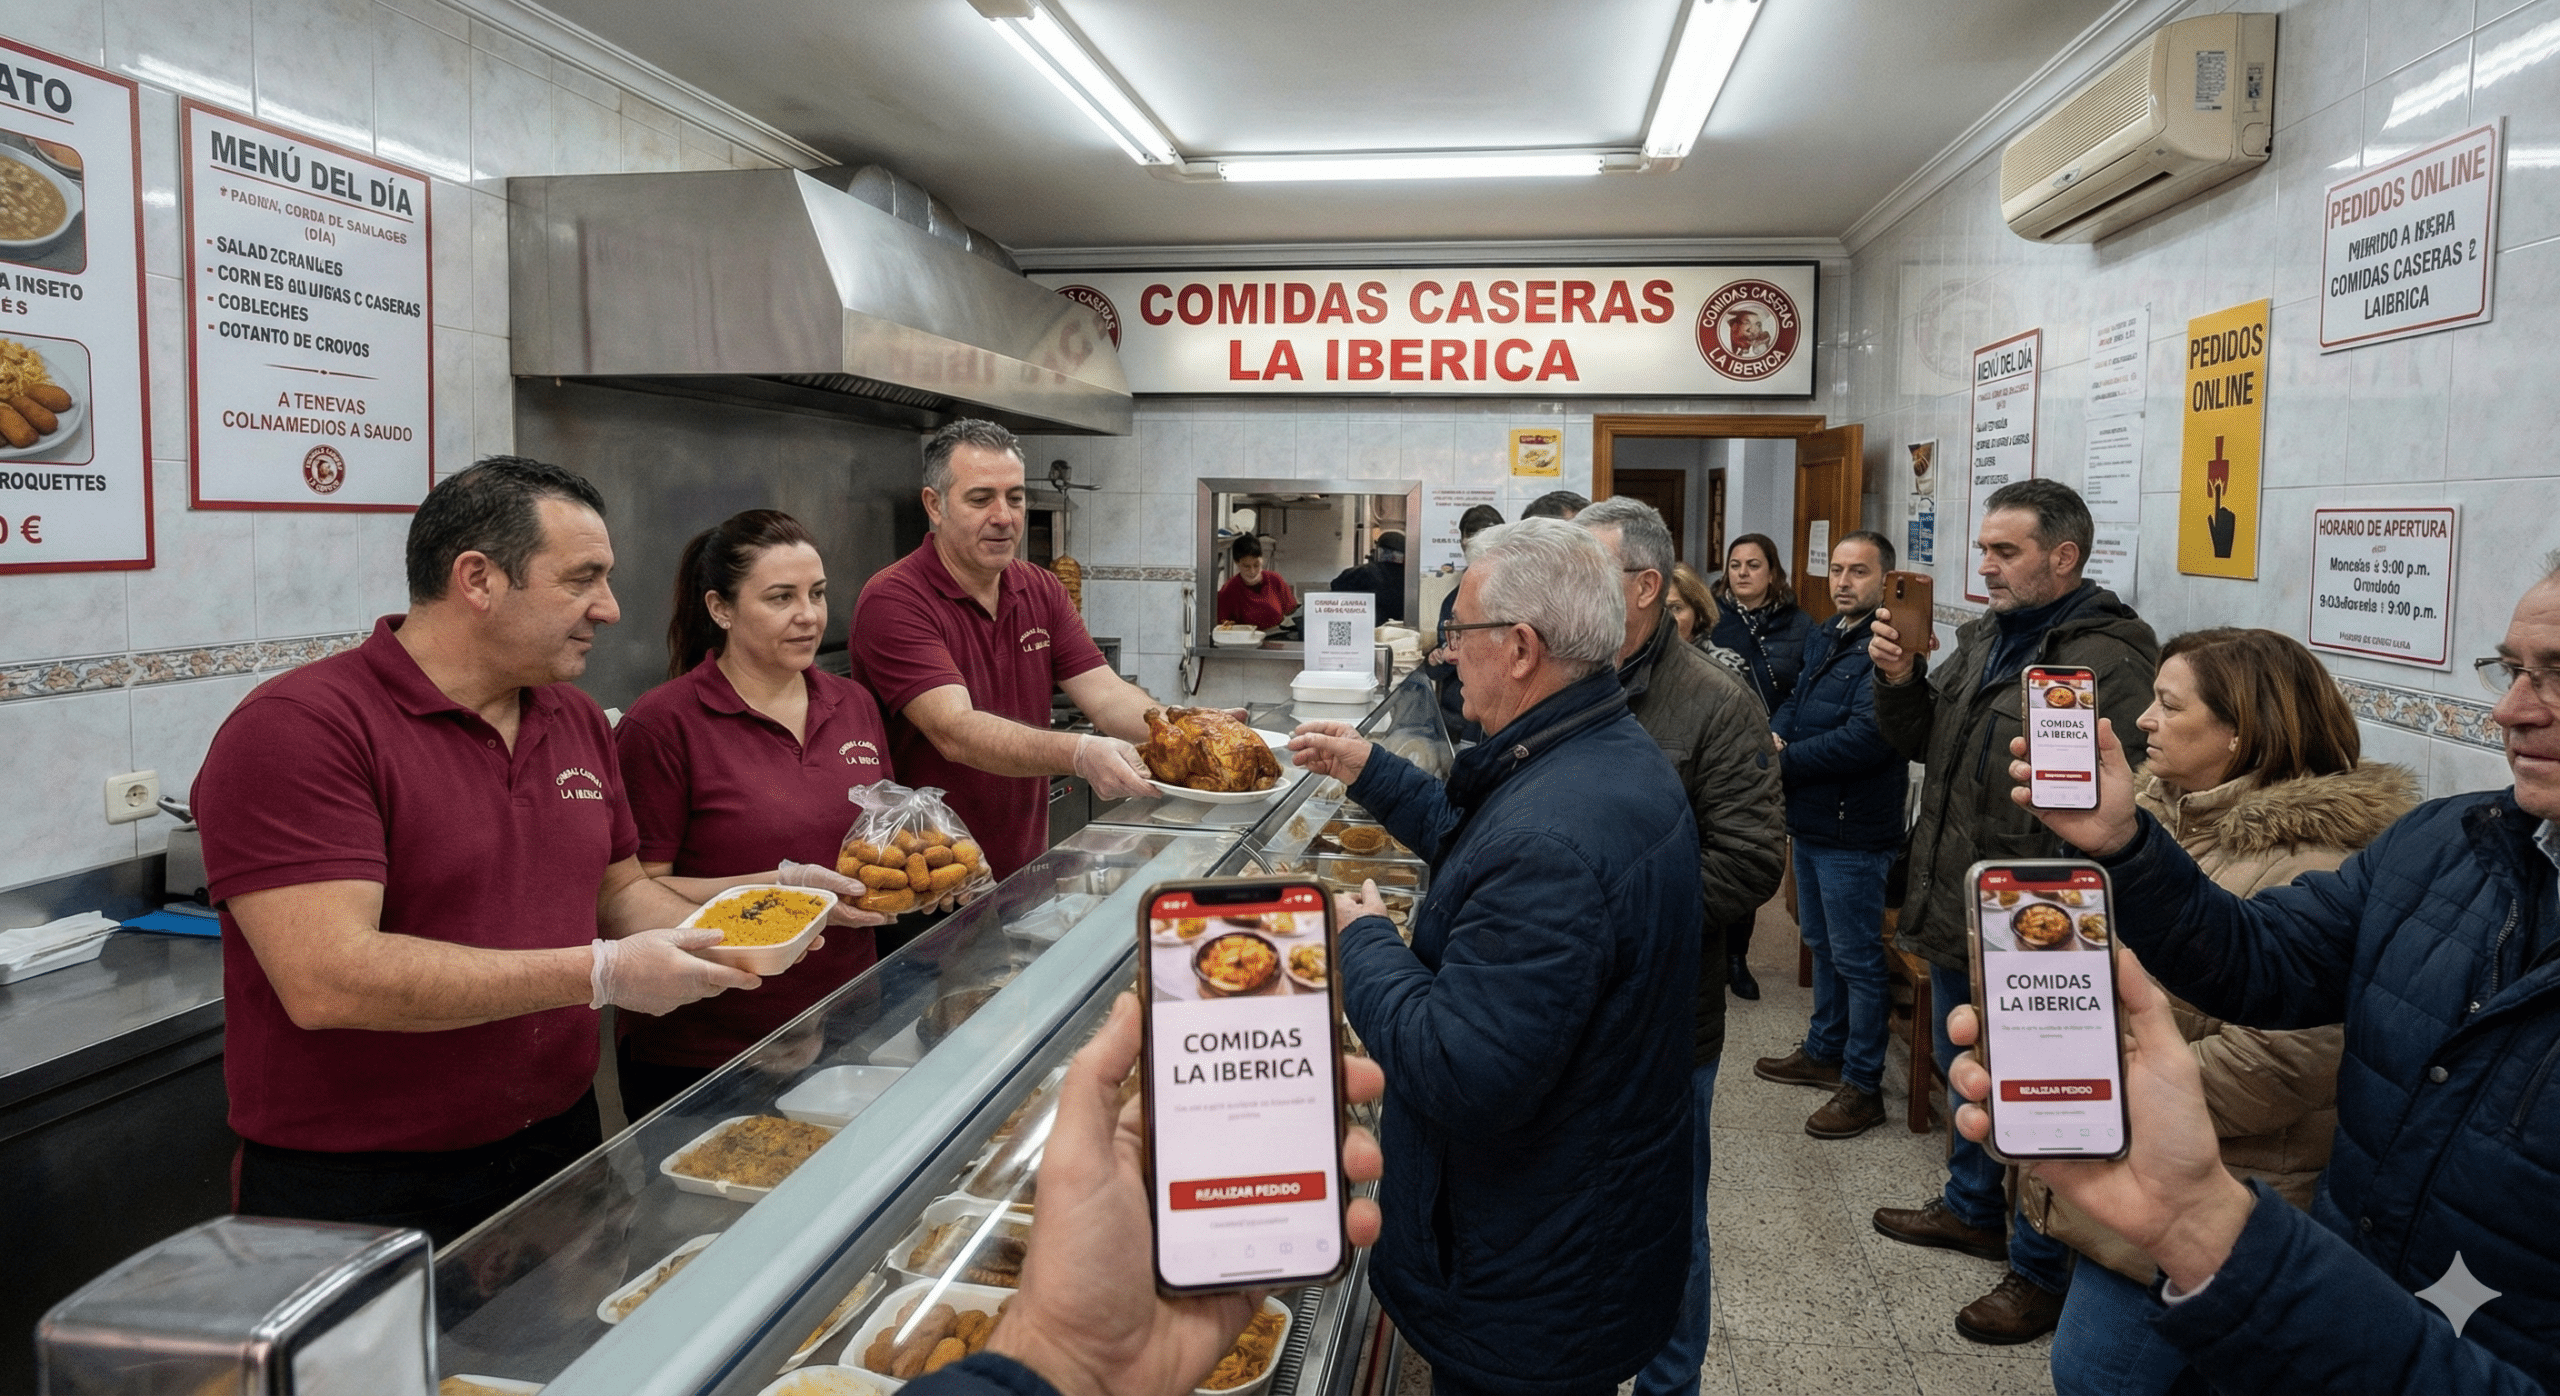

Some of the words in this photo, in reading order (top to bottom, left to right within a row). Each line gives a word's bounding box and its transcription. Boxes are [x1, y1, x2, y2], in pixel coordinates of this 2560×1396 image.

[211, 130, 300, 183] MENÚ
[311, 161, 362, 202] DEL
[370, 178, 413, 216] DÍA
[2330, 177, 2405, 230] PEDIDOS
[2411, 144, 2486, 201] ONLINE
[328, 214, 344, 229] DE
[2401, 224, 2411, 246] A
[217, 236, 267, 261] SALAD
[2331, 262, 2389, 297] COMIDAS
[2393, 241, 2463, 281] CASERAS
[15, 274, 84, 301] INSETO
[218, 265, 261, 288] CORN
[264, 273, 284, 291] ES
[365, 293, 421, 318] CASERAS
[218, 293, 309, 322] COBLECHES
[1140, 280, 1389, 326] COMIDAS
[1409, 279, 1675, 325] CASERAS
[1702, 286, 1748, 328] COMIDAS
[219, 321, 289, 345] COTANTO
[294, 332, 312, 349] DE
[2190, 323, 2264, 370] PEDIDOS
[1229, 339, 1304, 381] LA
[1326, 338, 1580, 382] IBERICA
[1709, 347, 1727, 367] LA
[2001, 352, 2016, 375] DEL
[2018, 342, 2033, 371] DÍA
[278, 391, 290, 408] A
[294, 392, 366, 415] TENEVAS
[2193, 371, 2254, 413] ONLINE
[223, 410, 346, 437] COLNAMEDIOS
[350, 422, 360, 437] A
[364, 423, 413, 442] SAUDO
[20, 515, 42, 544] €
[2319, 519, 2364, 536] HORARIO
[2367, 519, 2381, 537] DE
[2383, 519, 2447, 538] APERTURA
[2382, 559, 2404, 574] 9:00
[2407, 563, 2430, 578] p.m.
[2413, 605, 2437, 621] p.m.
[2037, 730, 2049, 738] LA
[2051, 730, 2089, 739] IBERICA
[2040, 719, 2084, 729] COMIDAS
[560, 789, 575, 799] LA
[2006, 974, 2091, 989] COMIDAS
[2000, 996, 2023, 1011] LA
[2028, 996, 2101, 1011] IBERICA
[1184, 1028, 1302, 1053] COMIDAS
[1174, 1064, 1205, 1085] LA
[1213, 1057, 1314, 1083] IBERICA
[1195, 1185, 1253, 1201] REALIZAR
[1255, 1182, 1301, 1198] PEDIDO
